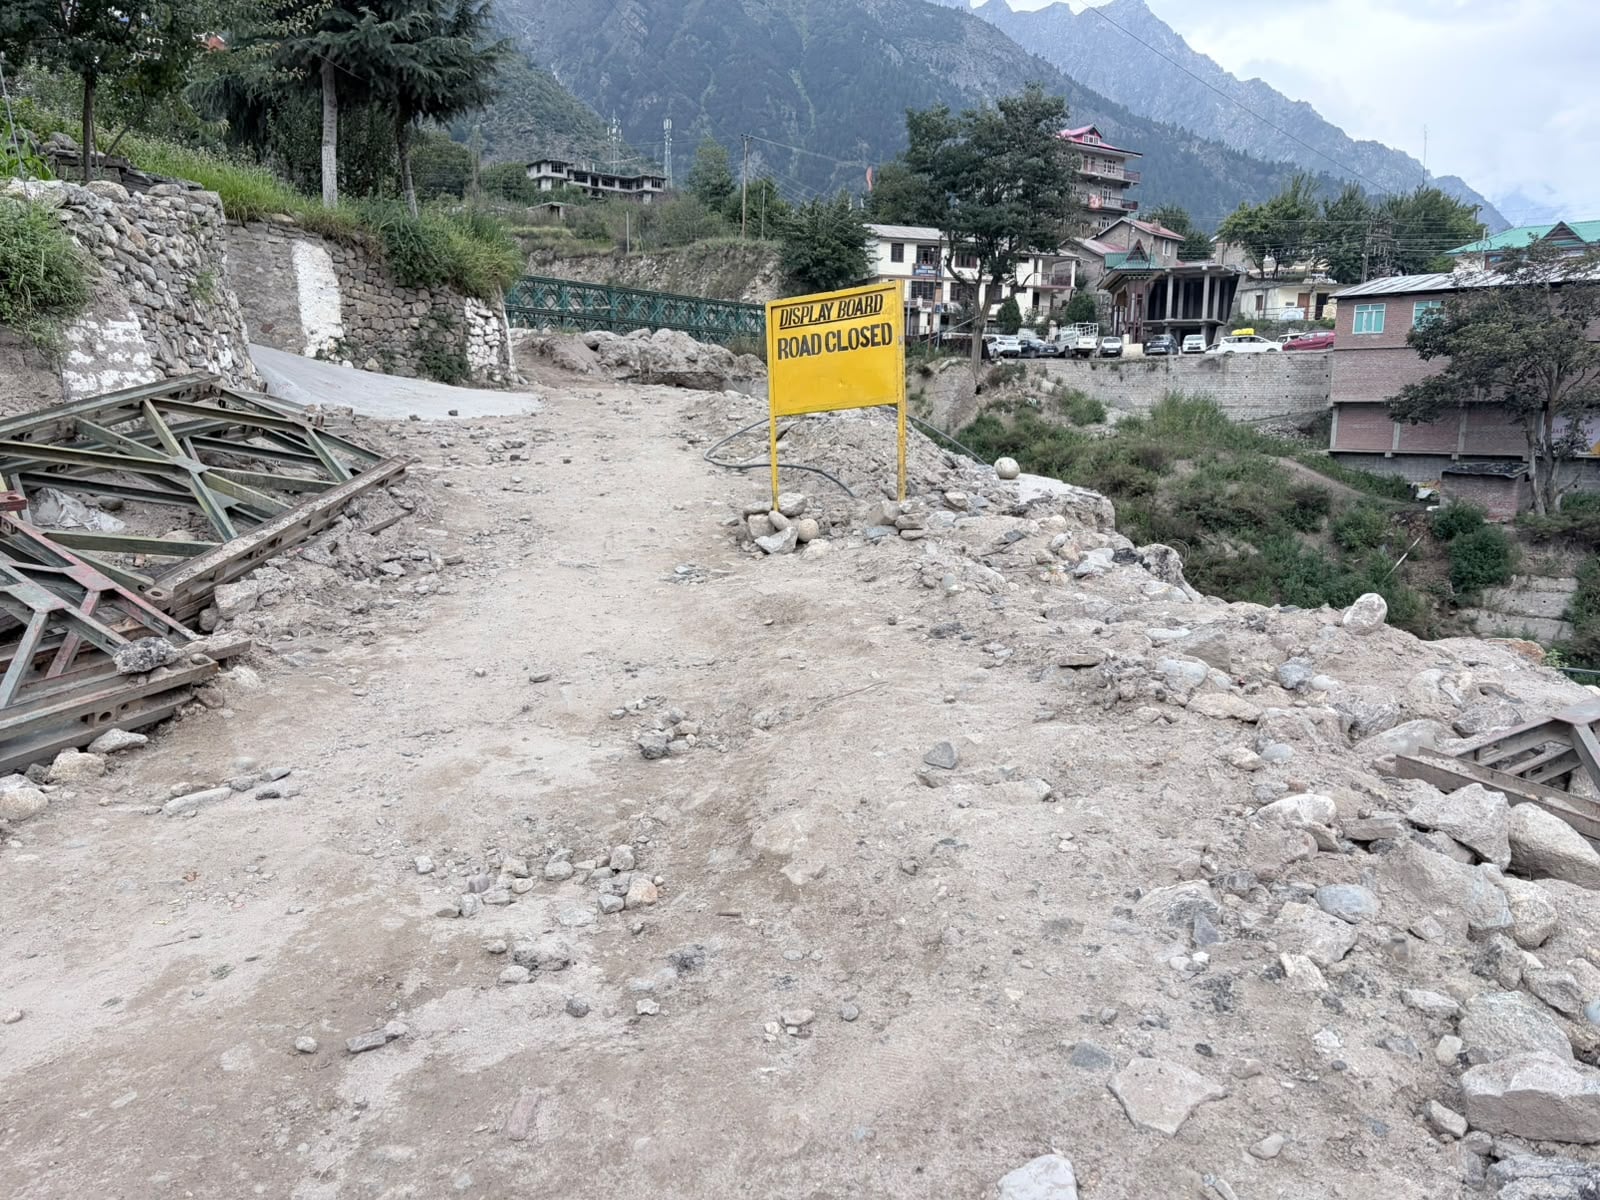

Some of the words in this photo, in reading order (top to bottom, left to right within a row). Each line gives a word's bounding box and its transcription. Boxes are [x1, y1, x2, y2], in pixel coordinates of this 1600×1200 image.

[780, 302, 834, 327] DISPLAY
[837, 294, 883, 318] BOARD
[778, 333, 821, 360] ROAD
[825, 323, 892, 353] CLOSED
